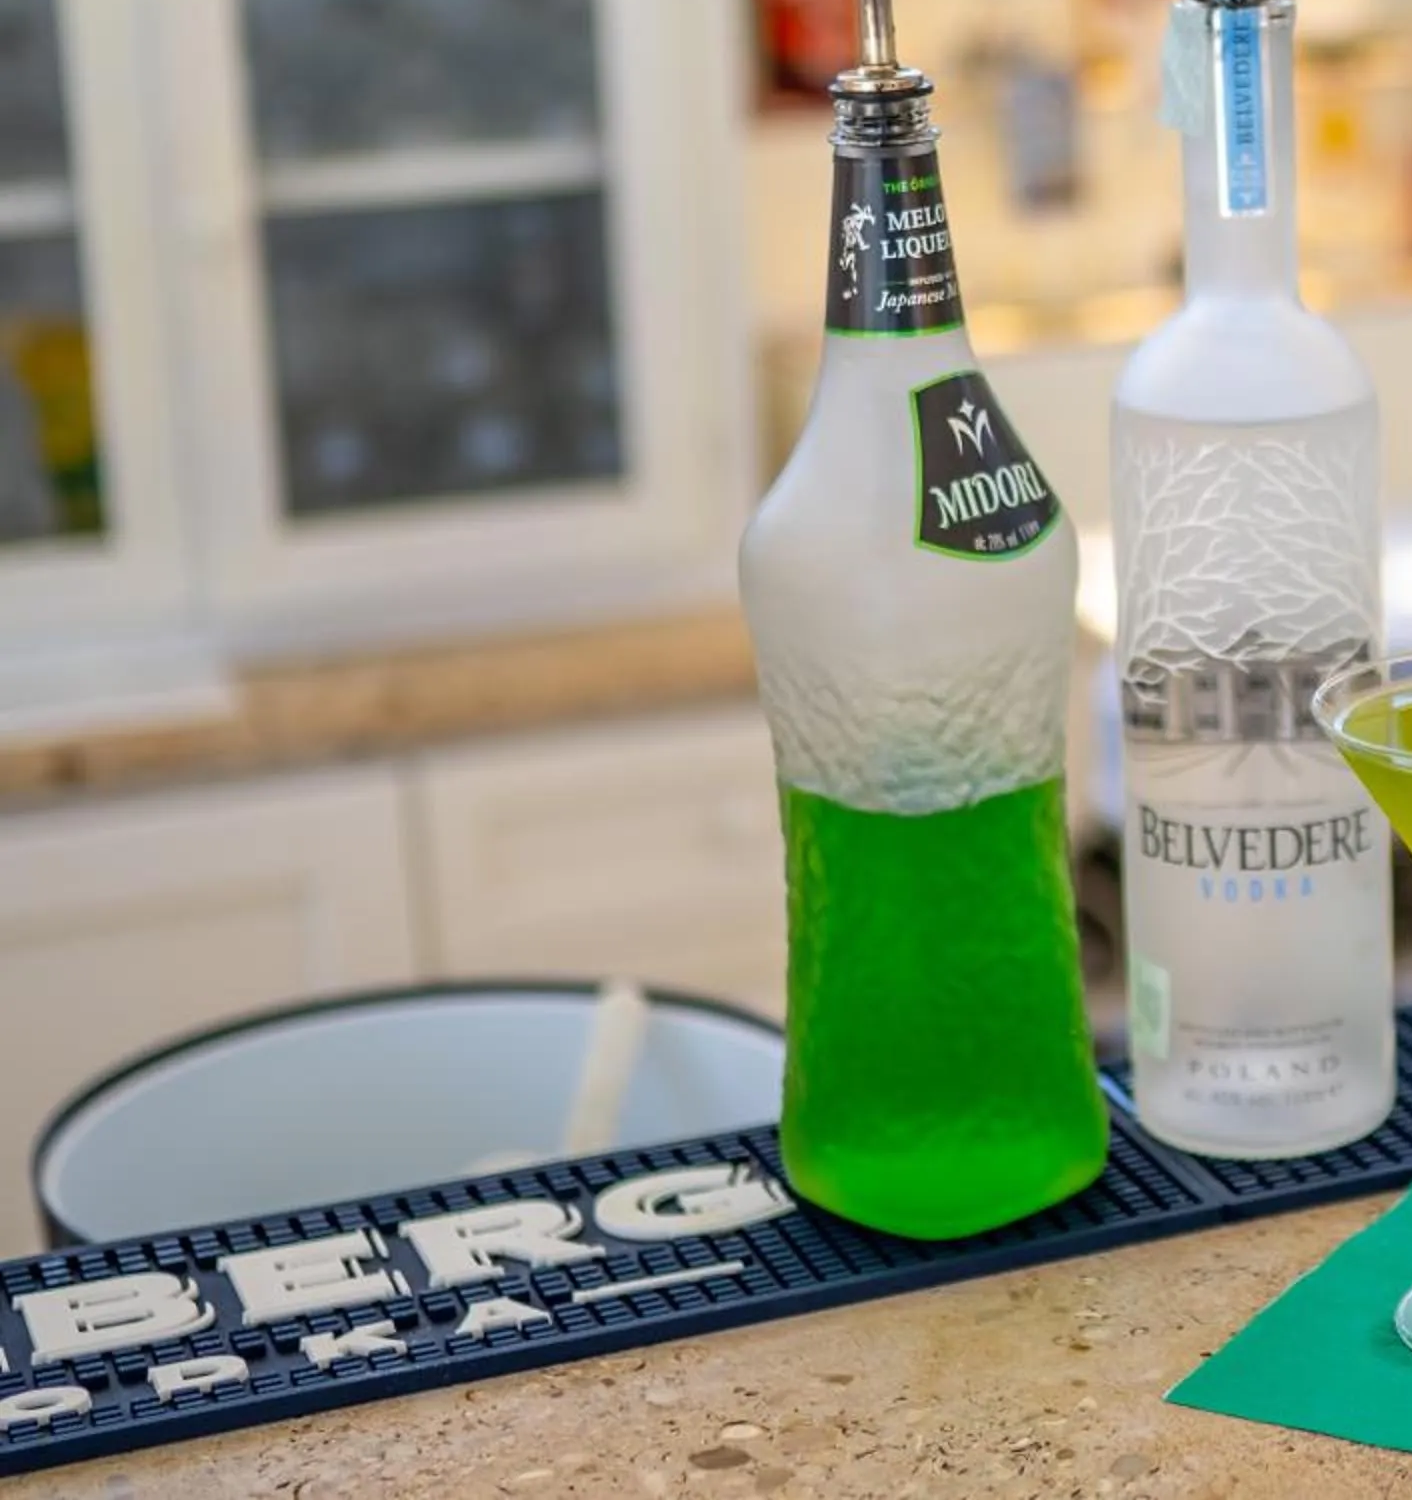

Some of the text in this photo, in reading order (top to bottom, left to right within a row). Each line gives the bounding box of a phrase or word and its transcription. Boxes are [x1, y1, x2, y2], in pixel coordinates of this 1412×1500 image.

[1231, 21, 1256, 146] BELVEDERE
[928, 461, 1047, 531] MIDORI
[1138, 803, 1372, 872] BELVEDERE
[1199, 873, 1315, 903] VODKA
[0, 1160, 799, 1374] BERG
